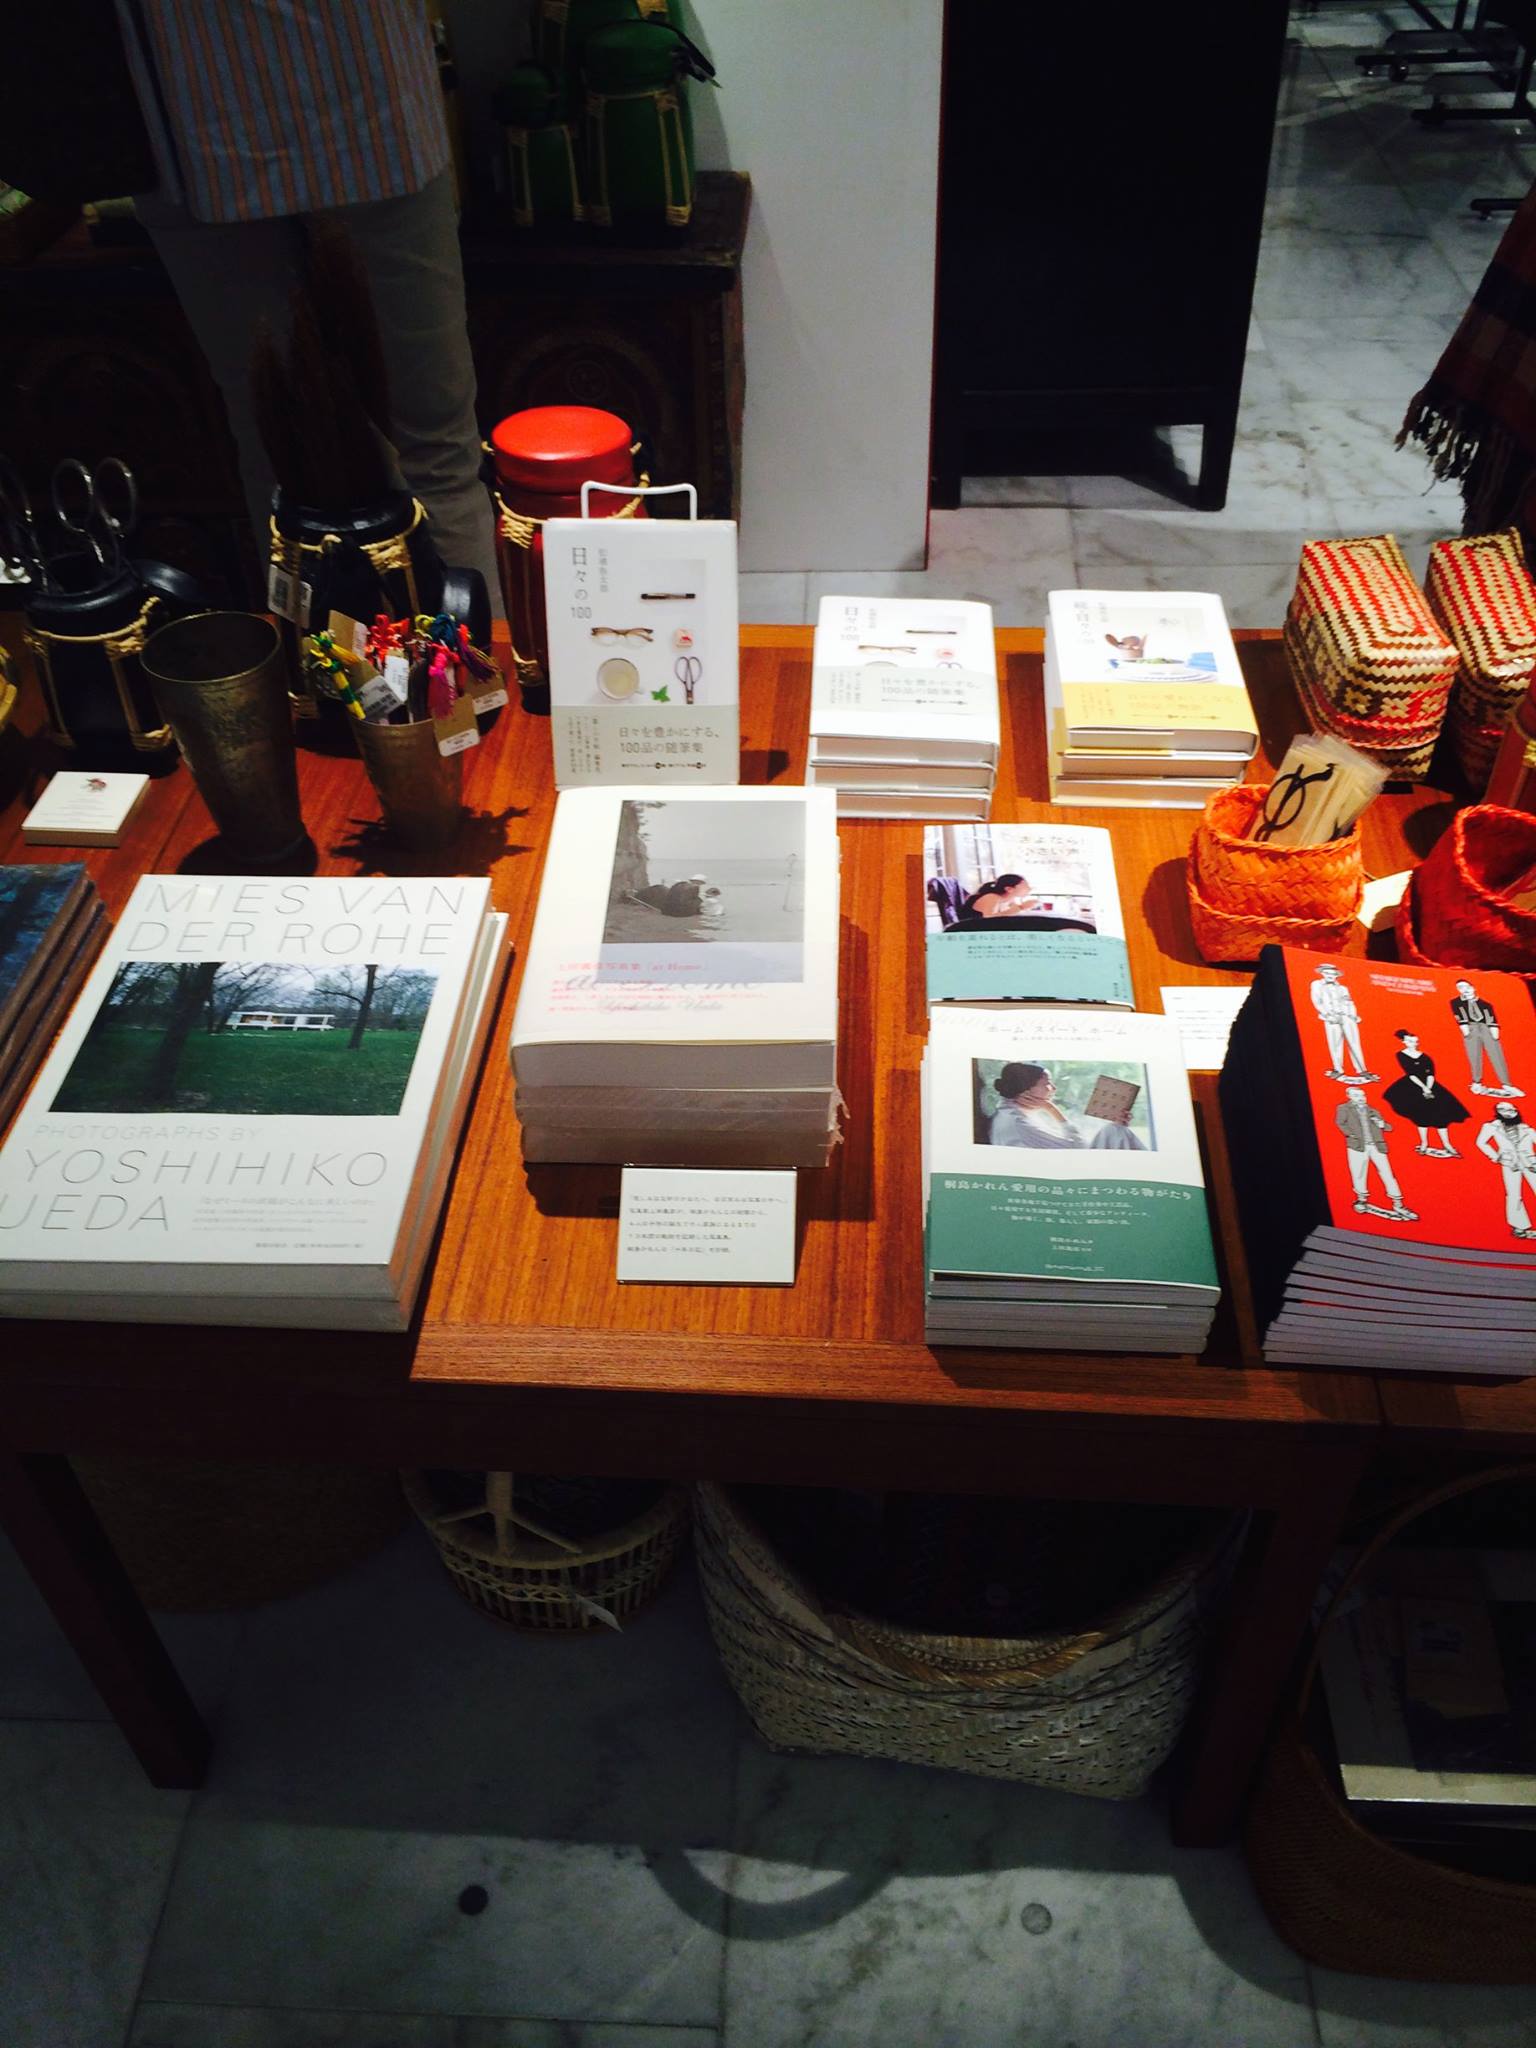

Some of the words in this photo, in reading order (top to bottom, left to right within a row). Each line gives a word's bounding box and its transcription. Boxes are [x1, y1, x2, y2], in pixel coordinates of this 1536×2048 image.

[144, 884, 311, 914] MIES
[337, 885, 466, 915] VAN
[126, 921, 256, 953] DER
[276, 922, 454, 955] ROHE
[34, 1123, 220, 1141] PHOTOGRAPHS
[230, 1126, 264, 1142] BY
[25, 1149, 388, 1187] YOSHIHIKO
[0, 1194, 169, 1231] UEDA
